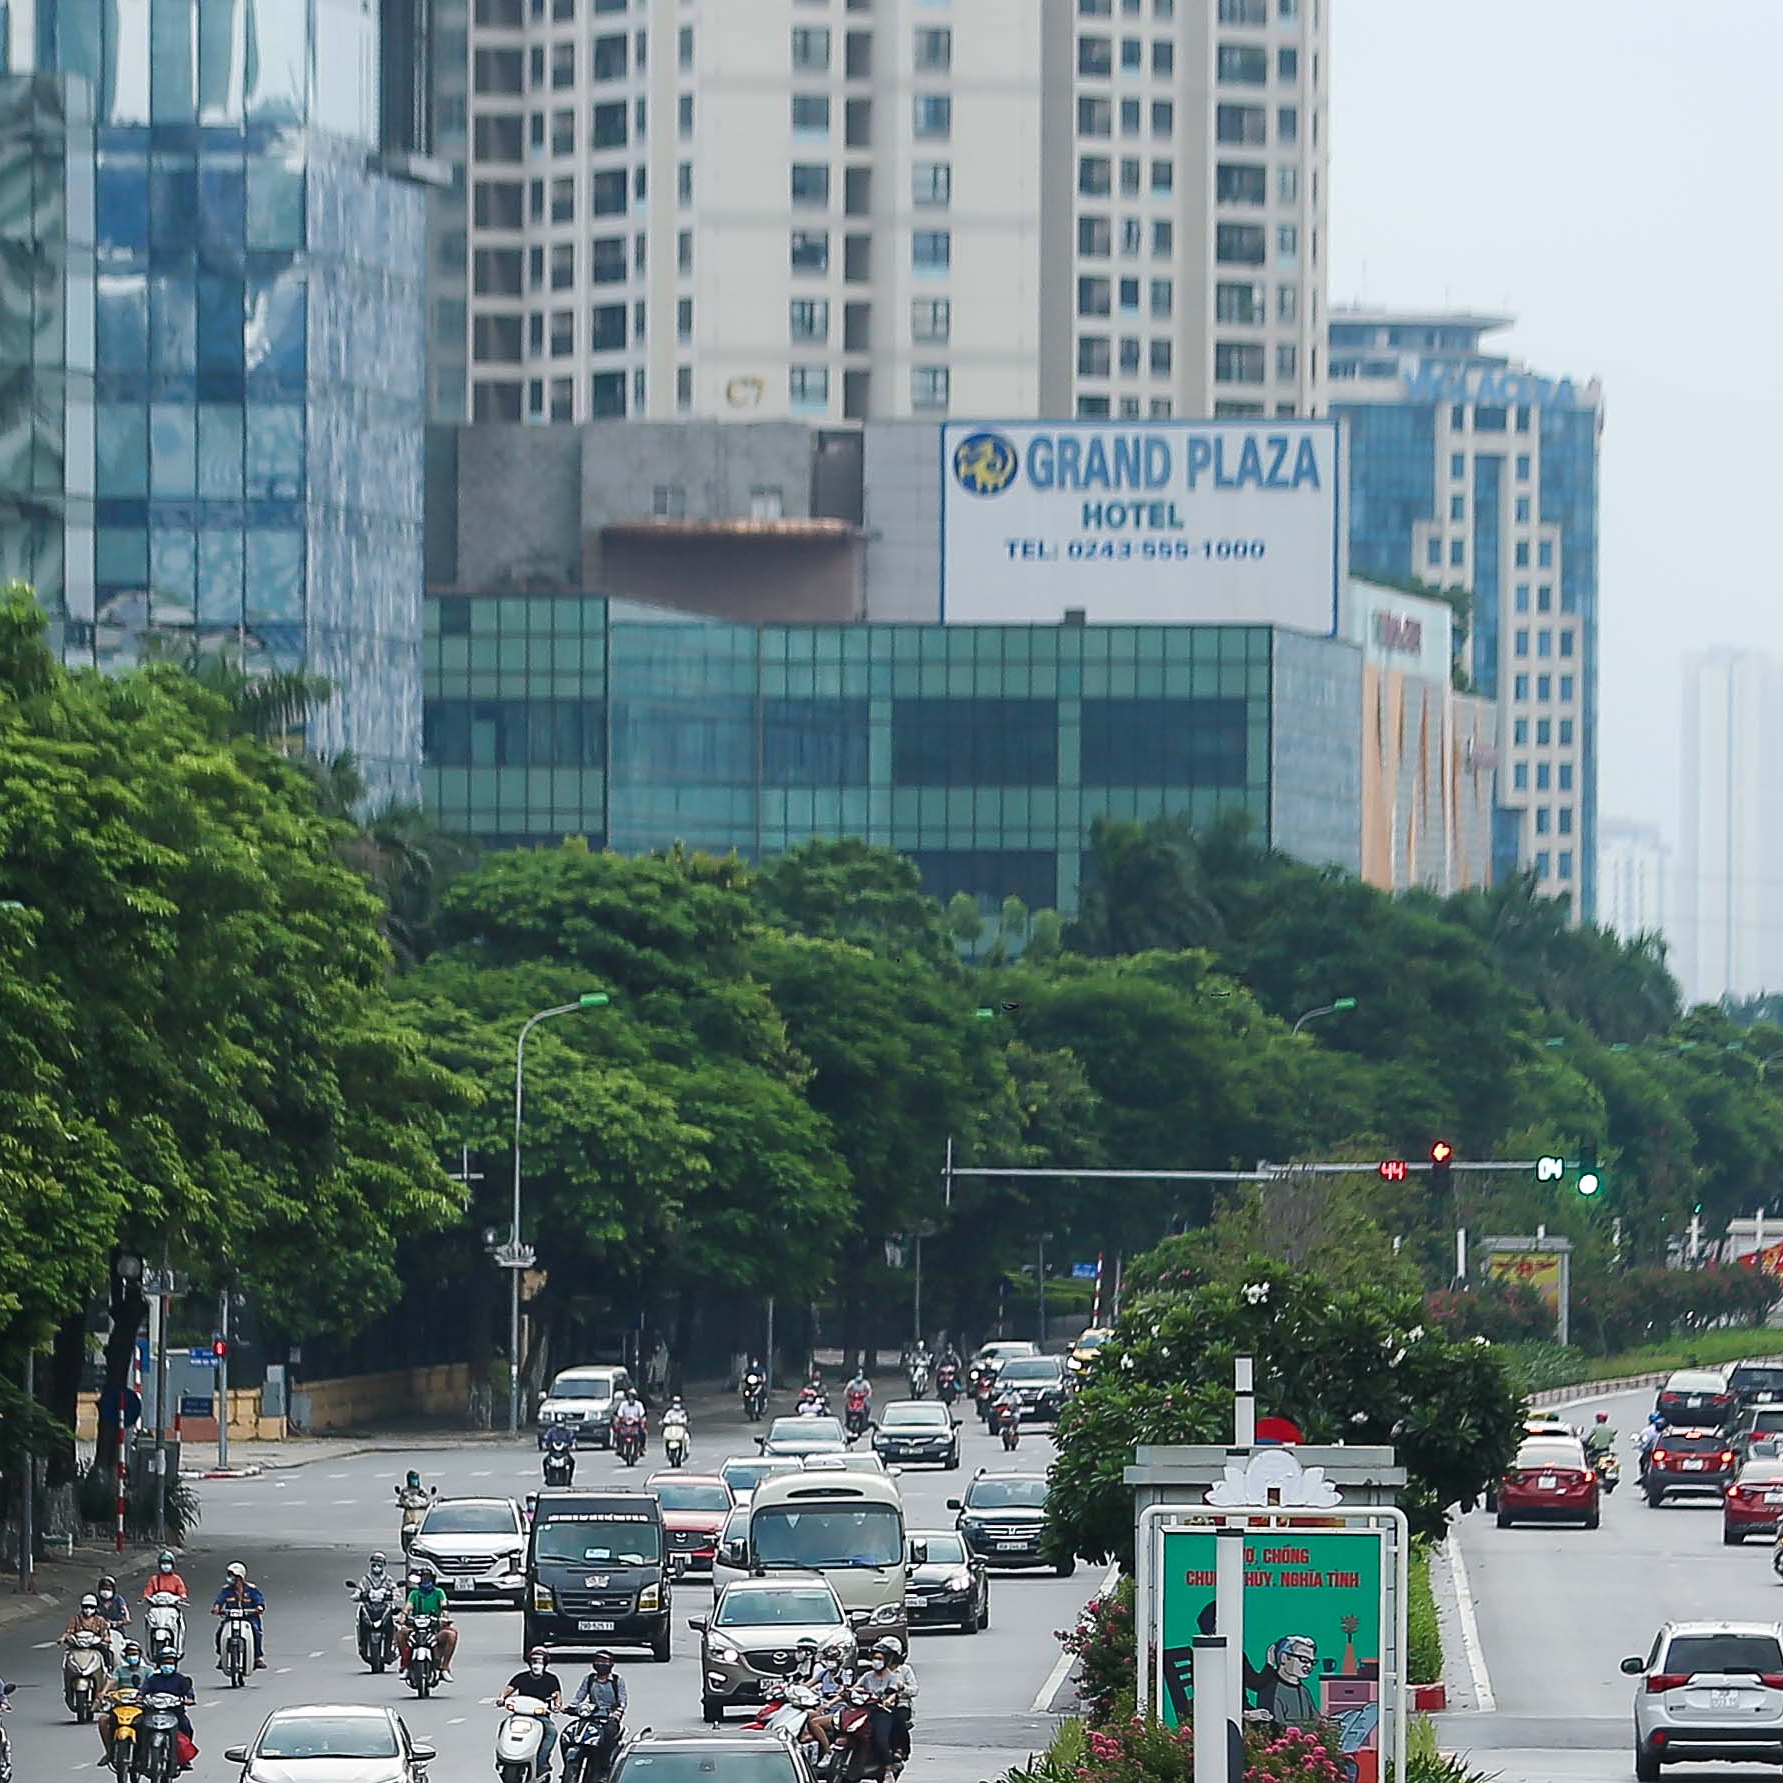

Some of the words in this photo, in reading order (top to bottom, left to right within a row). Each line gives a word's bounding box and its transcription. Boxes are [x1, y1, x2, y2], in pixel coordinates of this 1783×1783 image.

[1026, 433, 1172, 491] GRAND
[1186, 434, 1321, 492] PLAZA
[1081, 502, 1184, 530] HOTEL
[1002, 538, 1059, 561] TEL:
[1381, 1161, 1407, 1181] 44
[1537, 1156, 1564, 1181] 04
